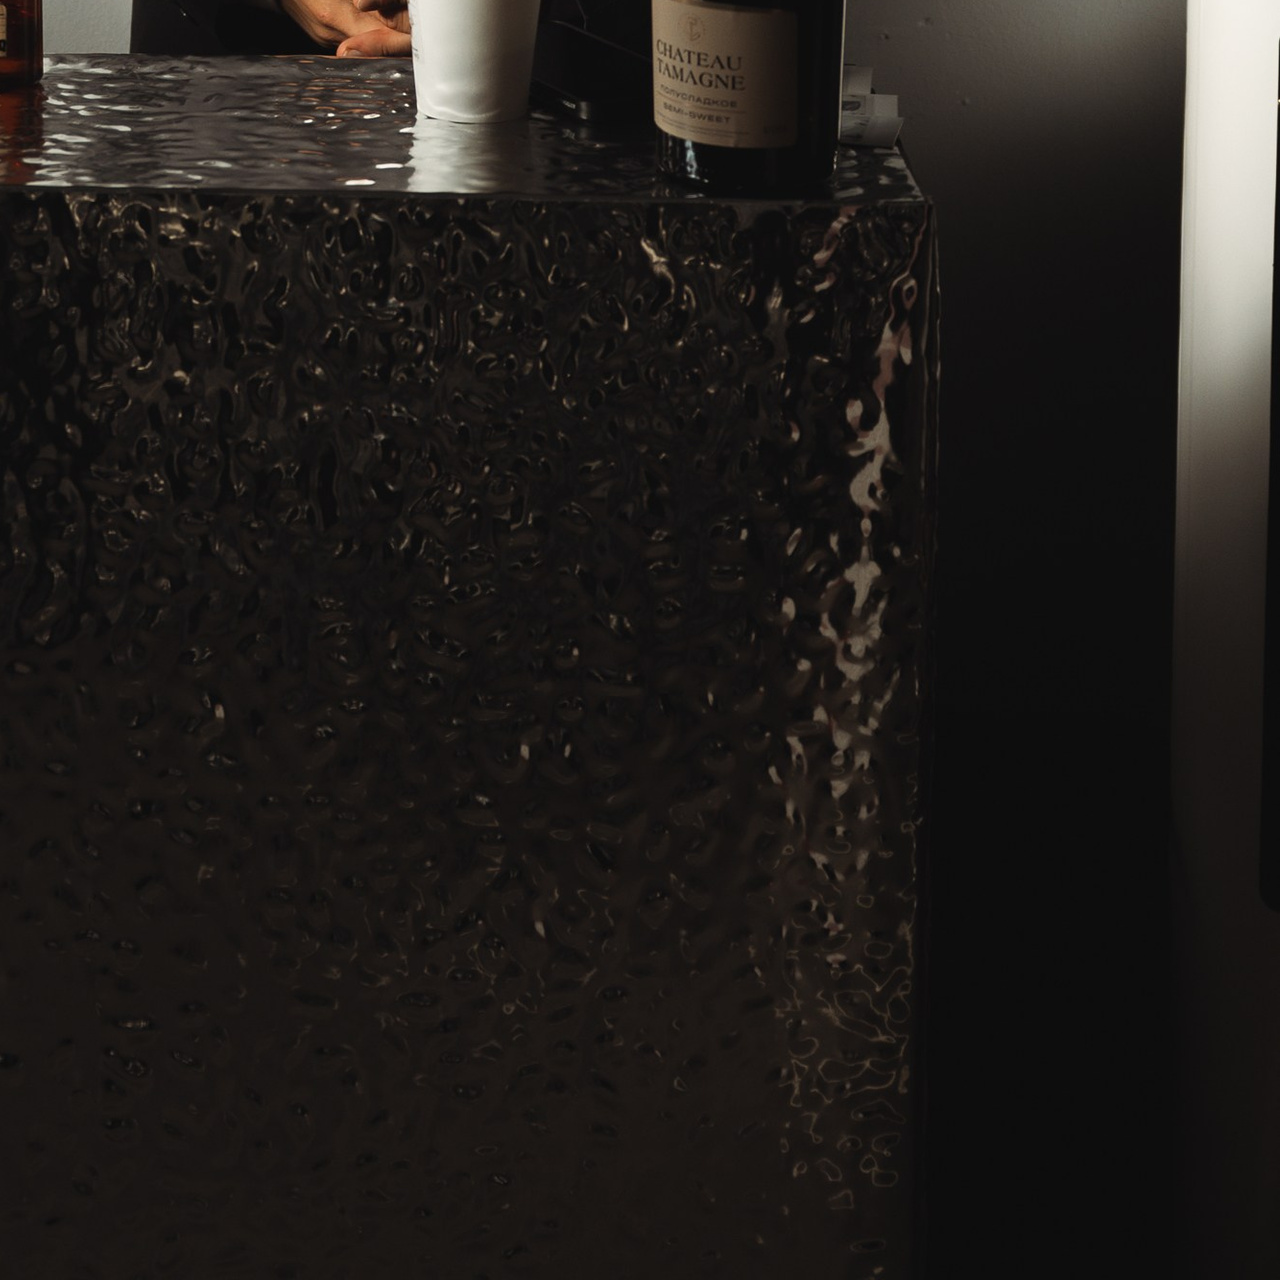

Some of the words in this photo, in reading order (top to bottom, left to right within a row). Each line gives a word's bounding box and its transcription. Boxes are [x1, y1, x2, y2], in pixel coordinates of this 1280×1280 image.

[656, 39, 743, 73] CHATEAU
[657, 58, 746, 91] TAMAGNE
[661, 85, 738, 108] ПОЛУСЛАДКОЕ
[663, 102, 732, 124] SEMI-SWEET
